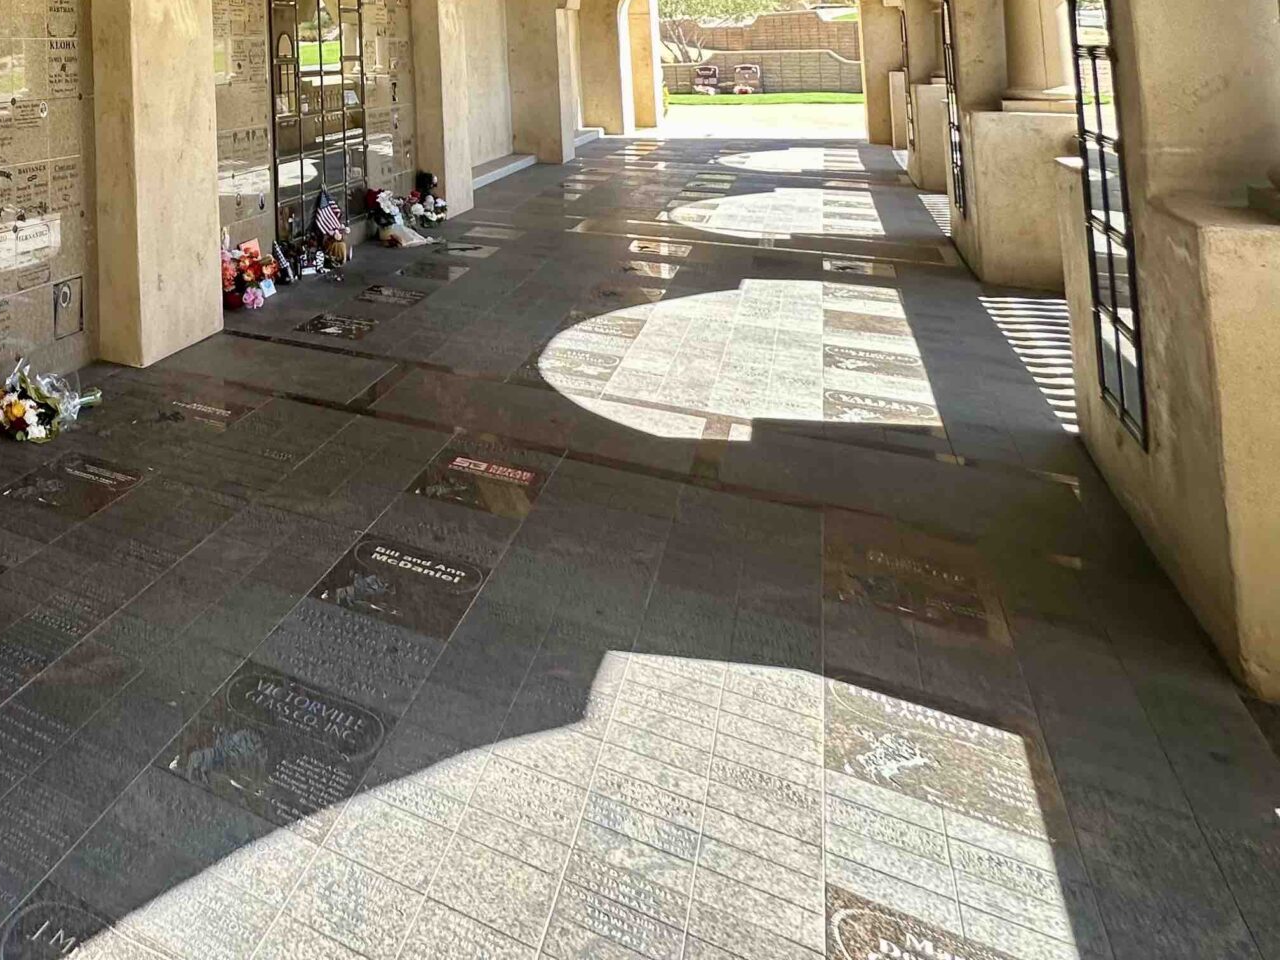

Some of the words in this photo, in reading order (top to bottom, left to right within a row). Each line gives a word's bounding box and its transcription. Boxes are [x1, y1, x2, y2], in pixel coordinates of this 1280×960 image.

[49, 41, 76, 50] KLOHA
[371, 552, 463, 585] McDaniel
[375, 545, 400, 559] Bill
[403, 554, 432, 568] and
[434, 562, 467, 578] Ann
[245, 690, 291, 716] GLASS
[255, 678, 366, 733] VICTORVILLE
